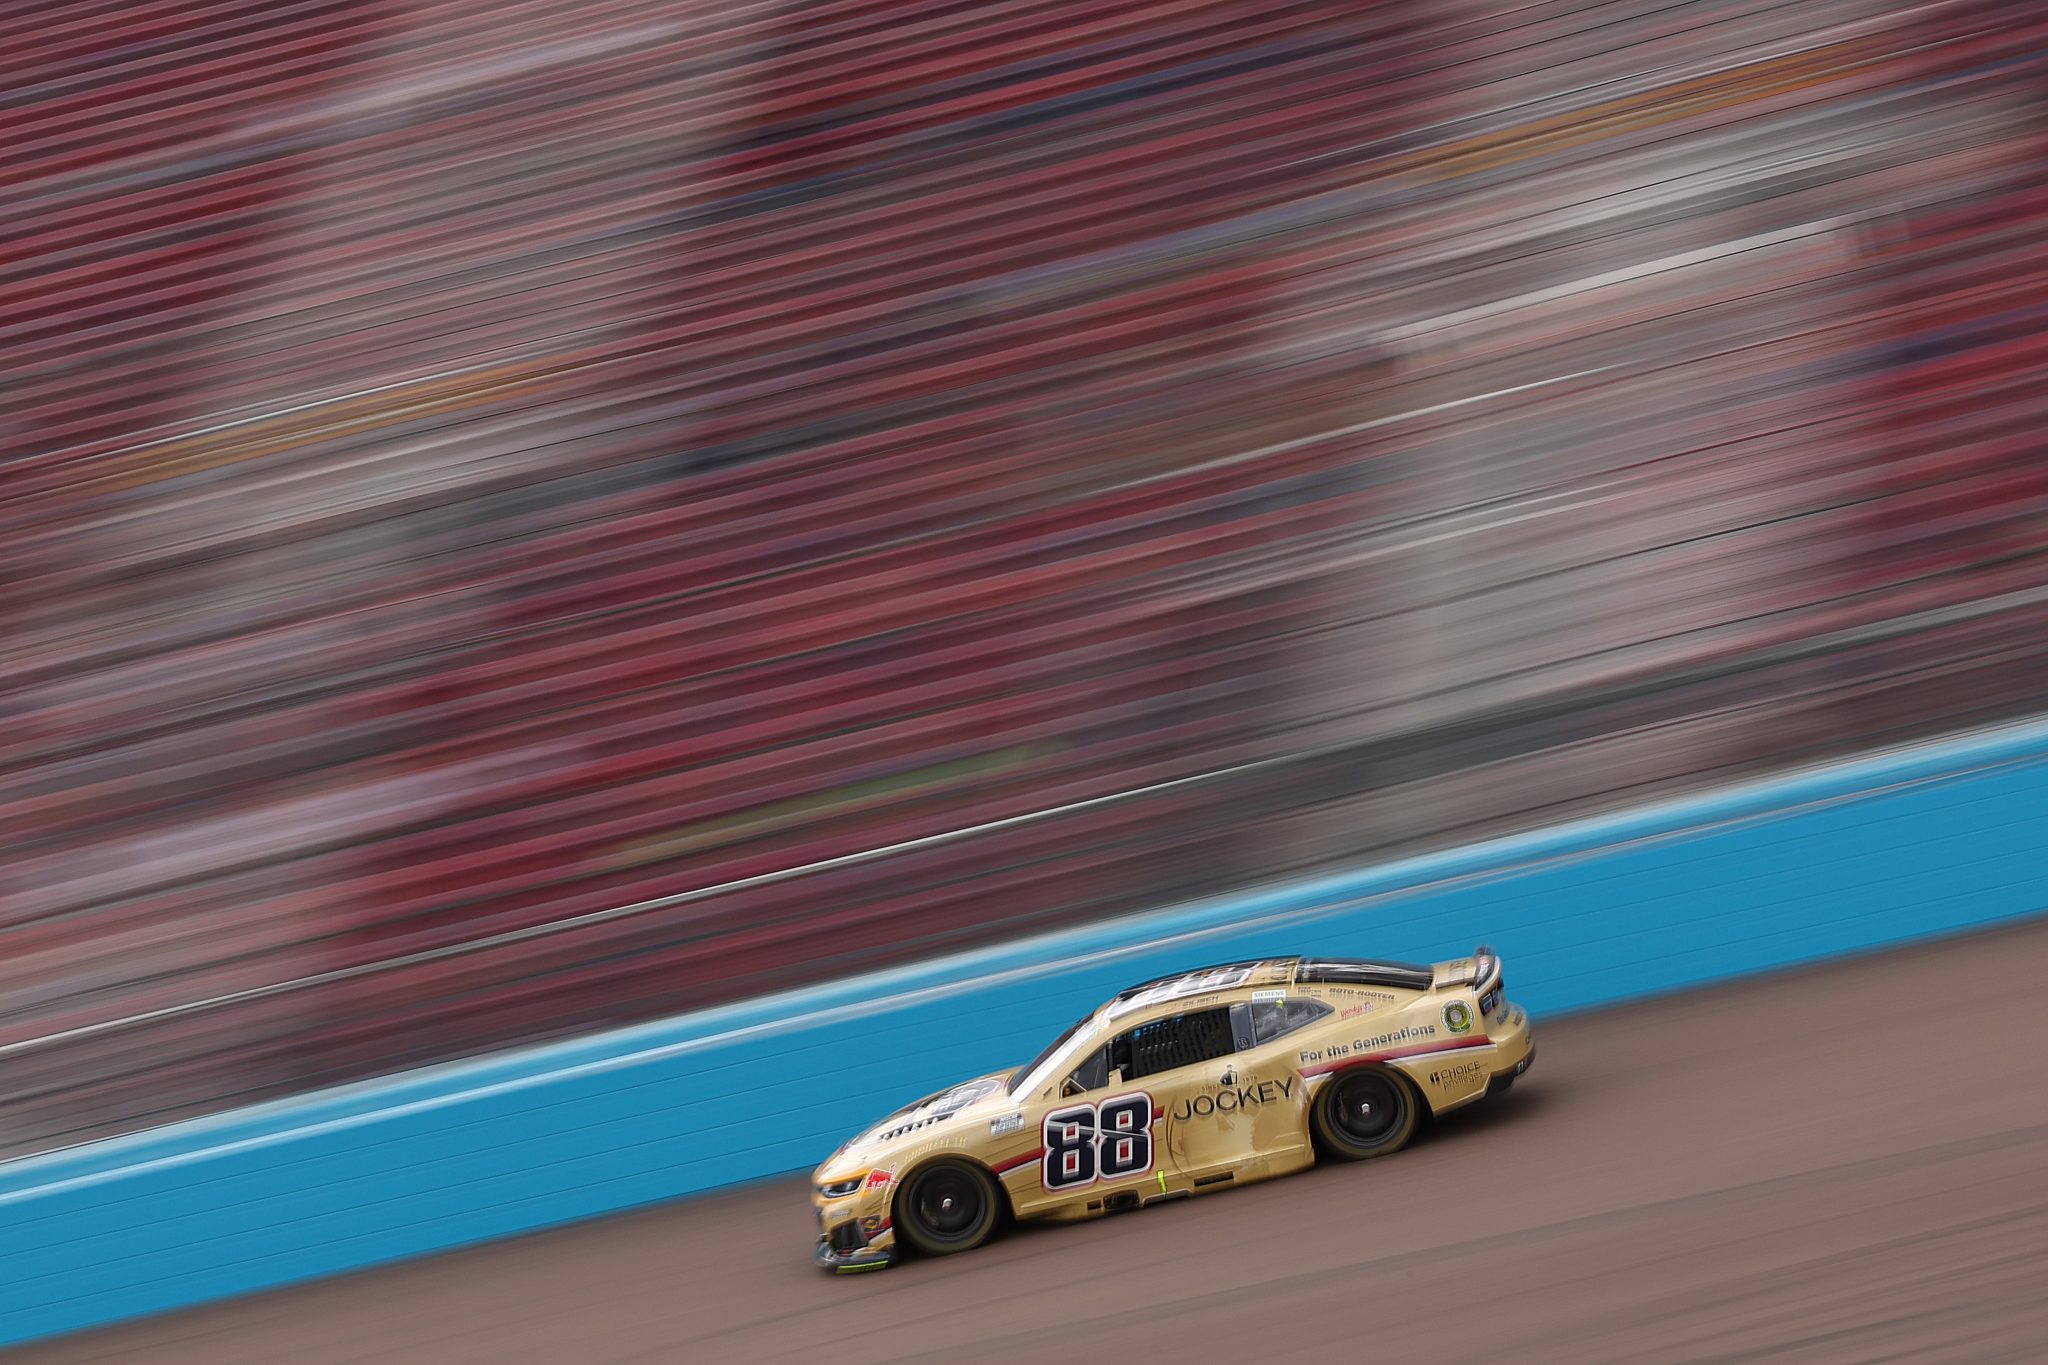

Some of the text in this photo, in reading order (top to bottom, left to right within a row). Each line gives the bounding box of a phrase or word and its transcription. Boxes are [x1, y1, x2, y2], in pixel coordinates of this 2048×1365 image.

[1329, 987, 1395, 999] ROTO-ROOTER
[1300, 1024, 1436, 1062] For the Generations
[1440, 1060, 1481, 1079] CHOICE
[1173, 1076, 1293, 1121] JOCKEY
[1041, 1089, 1155, 1192] 88
